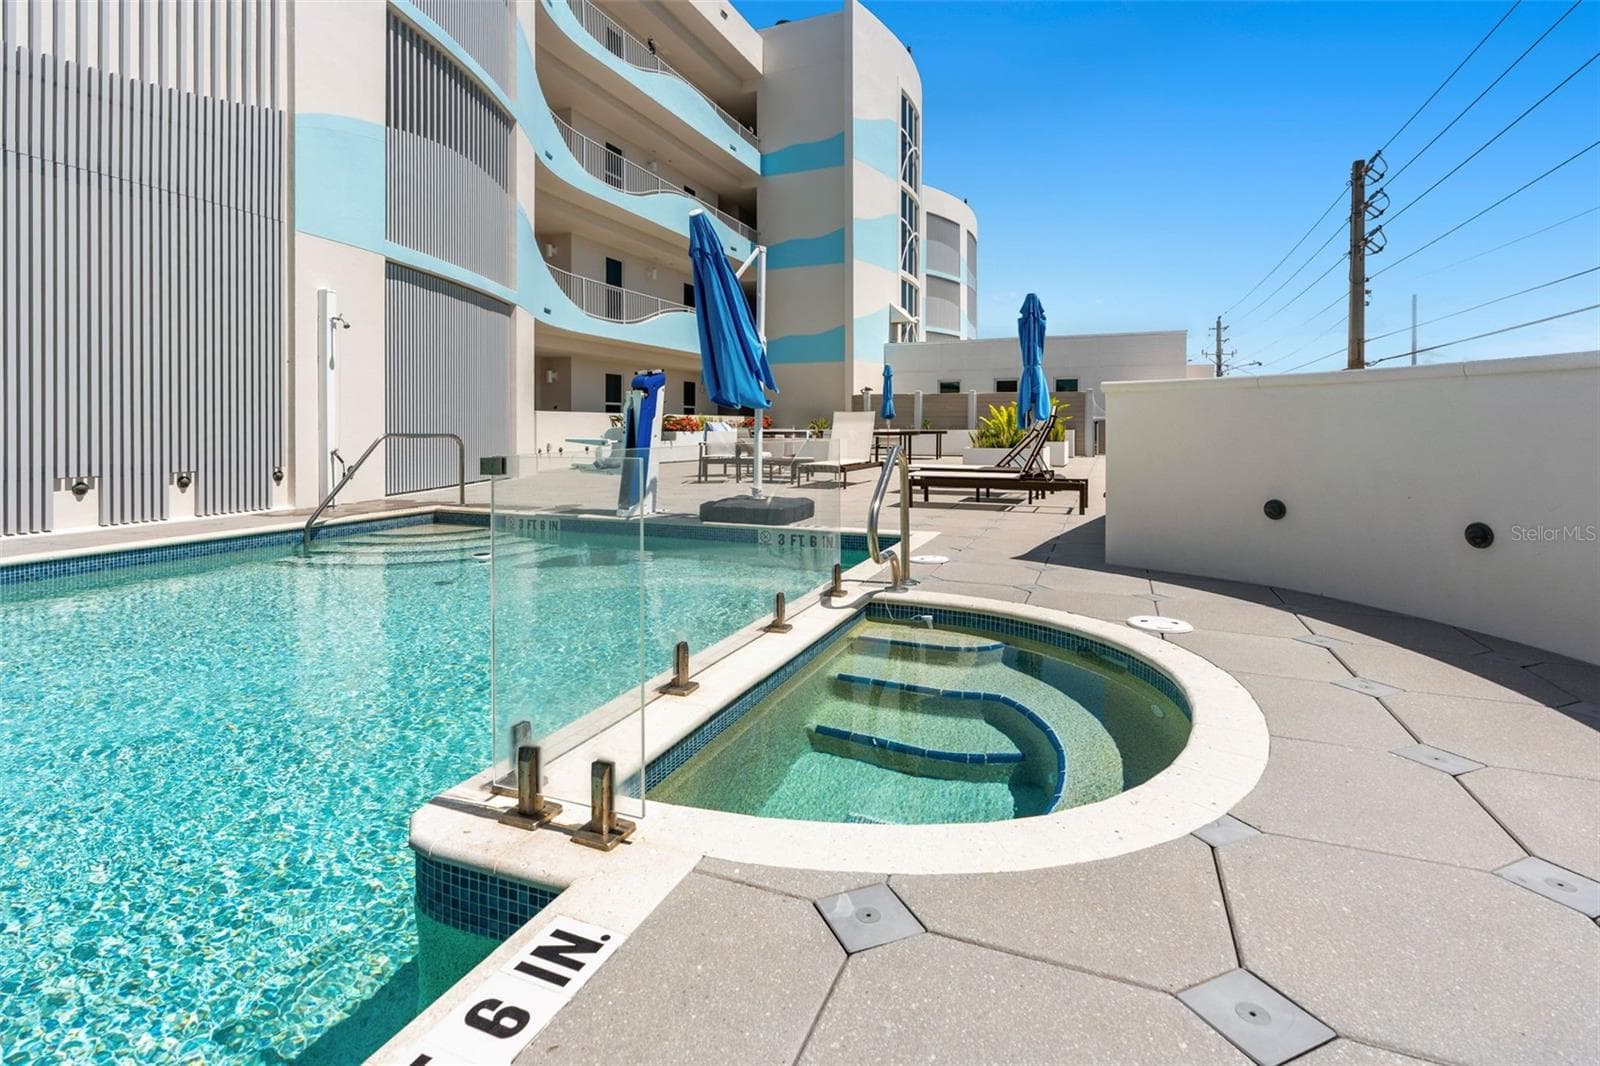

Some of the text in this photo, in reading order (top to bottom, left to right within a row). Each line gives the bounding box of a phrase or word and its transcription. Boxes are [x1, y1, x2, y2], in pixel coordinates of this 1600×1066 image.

[778, 533, 785, 546] 3
[810, 535, 817, 548] 6
[464, 928, 611, 1039] 6 IN.
